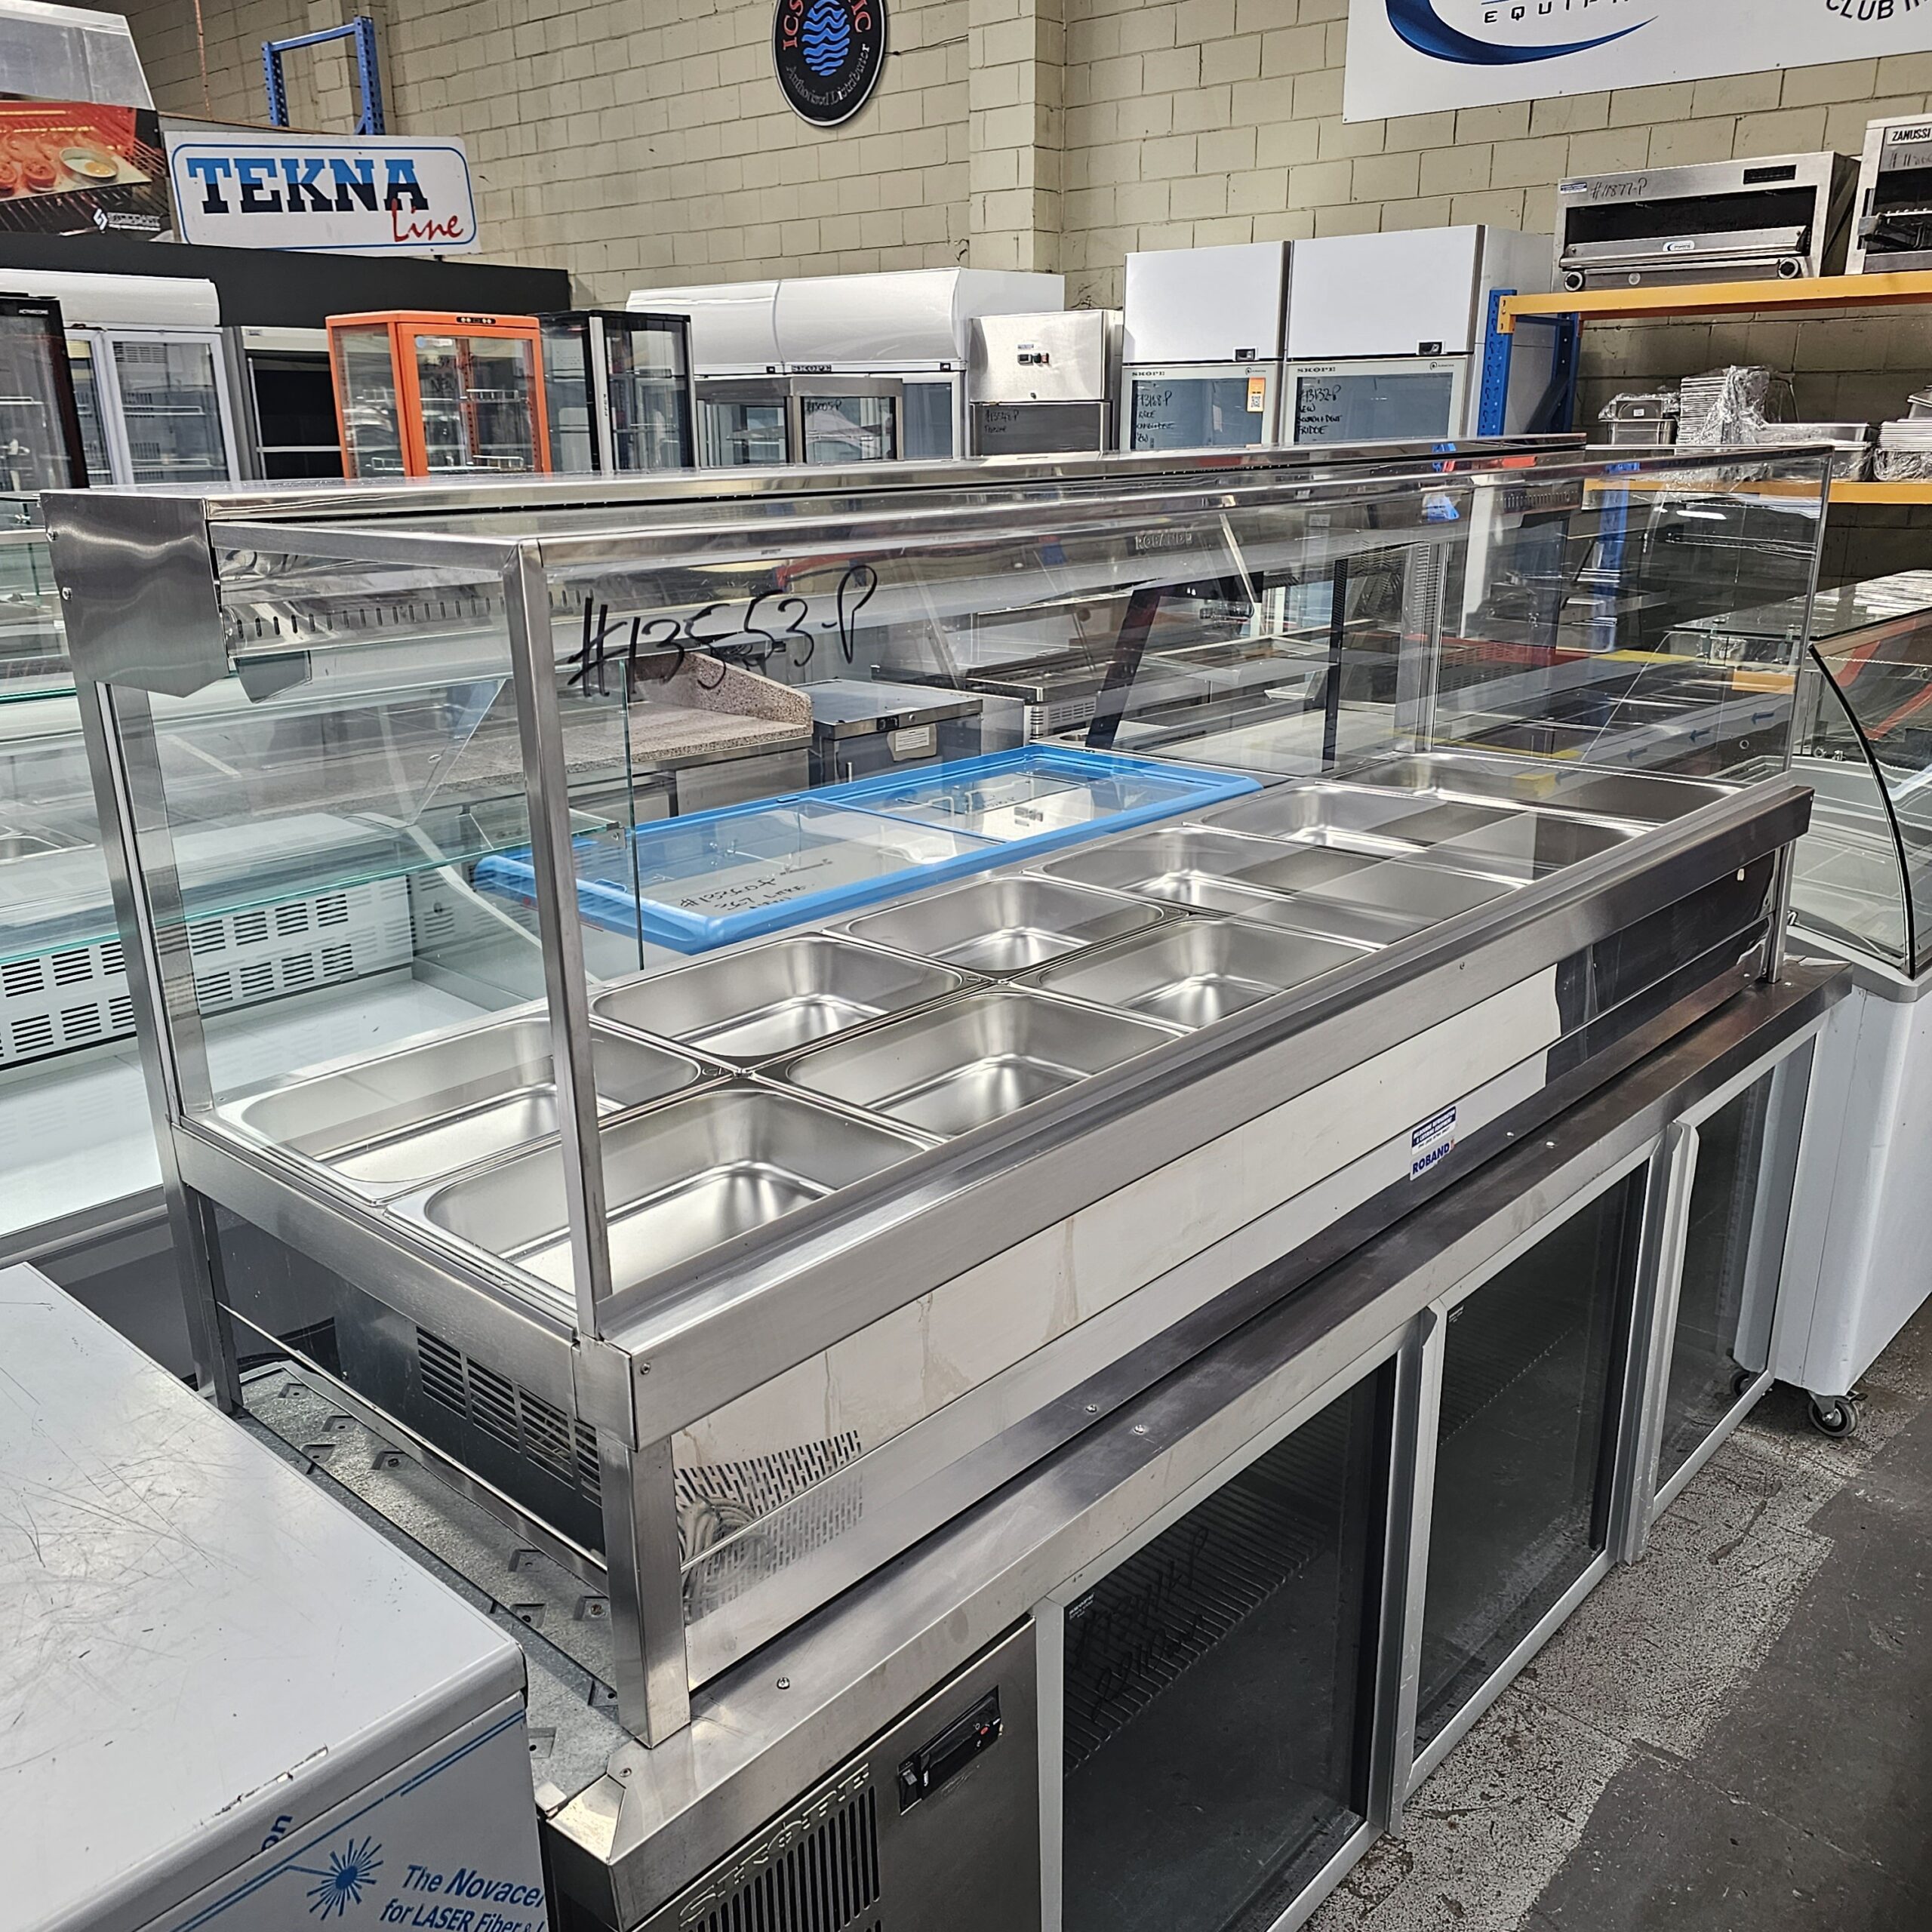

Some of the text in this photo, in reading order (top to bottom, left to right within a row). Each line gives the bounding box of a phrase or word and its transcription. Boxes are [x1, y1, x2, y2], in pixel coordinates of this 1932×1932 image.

[1484, 0, 1629, 23] EQUIP
[1826, 0, 1894, 21] CLUB
[1892, 127, 1931, 142] ZANUSSI
[186, 157, 429, 214] TEKNA
[1589, 177, 1647, 201] #11877-P
[390, 198, 464, 242] Line
[791, 365, 832, 374] SKOPE
[1413, 1143, 1450, 1175] ROBAND
[402, 1864, 444, 1893] The
[380, 1898, 414, 1924] for
[412, 1903, 475, 1932] LASER
[474, 1912, 525, 1932] Fiber
